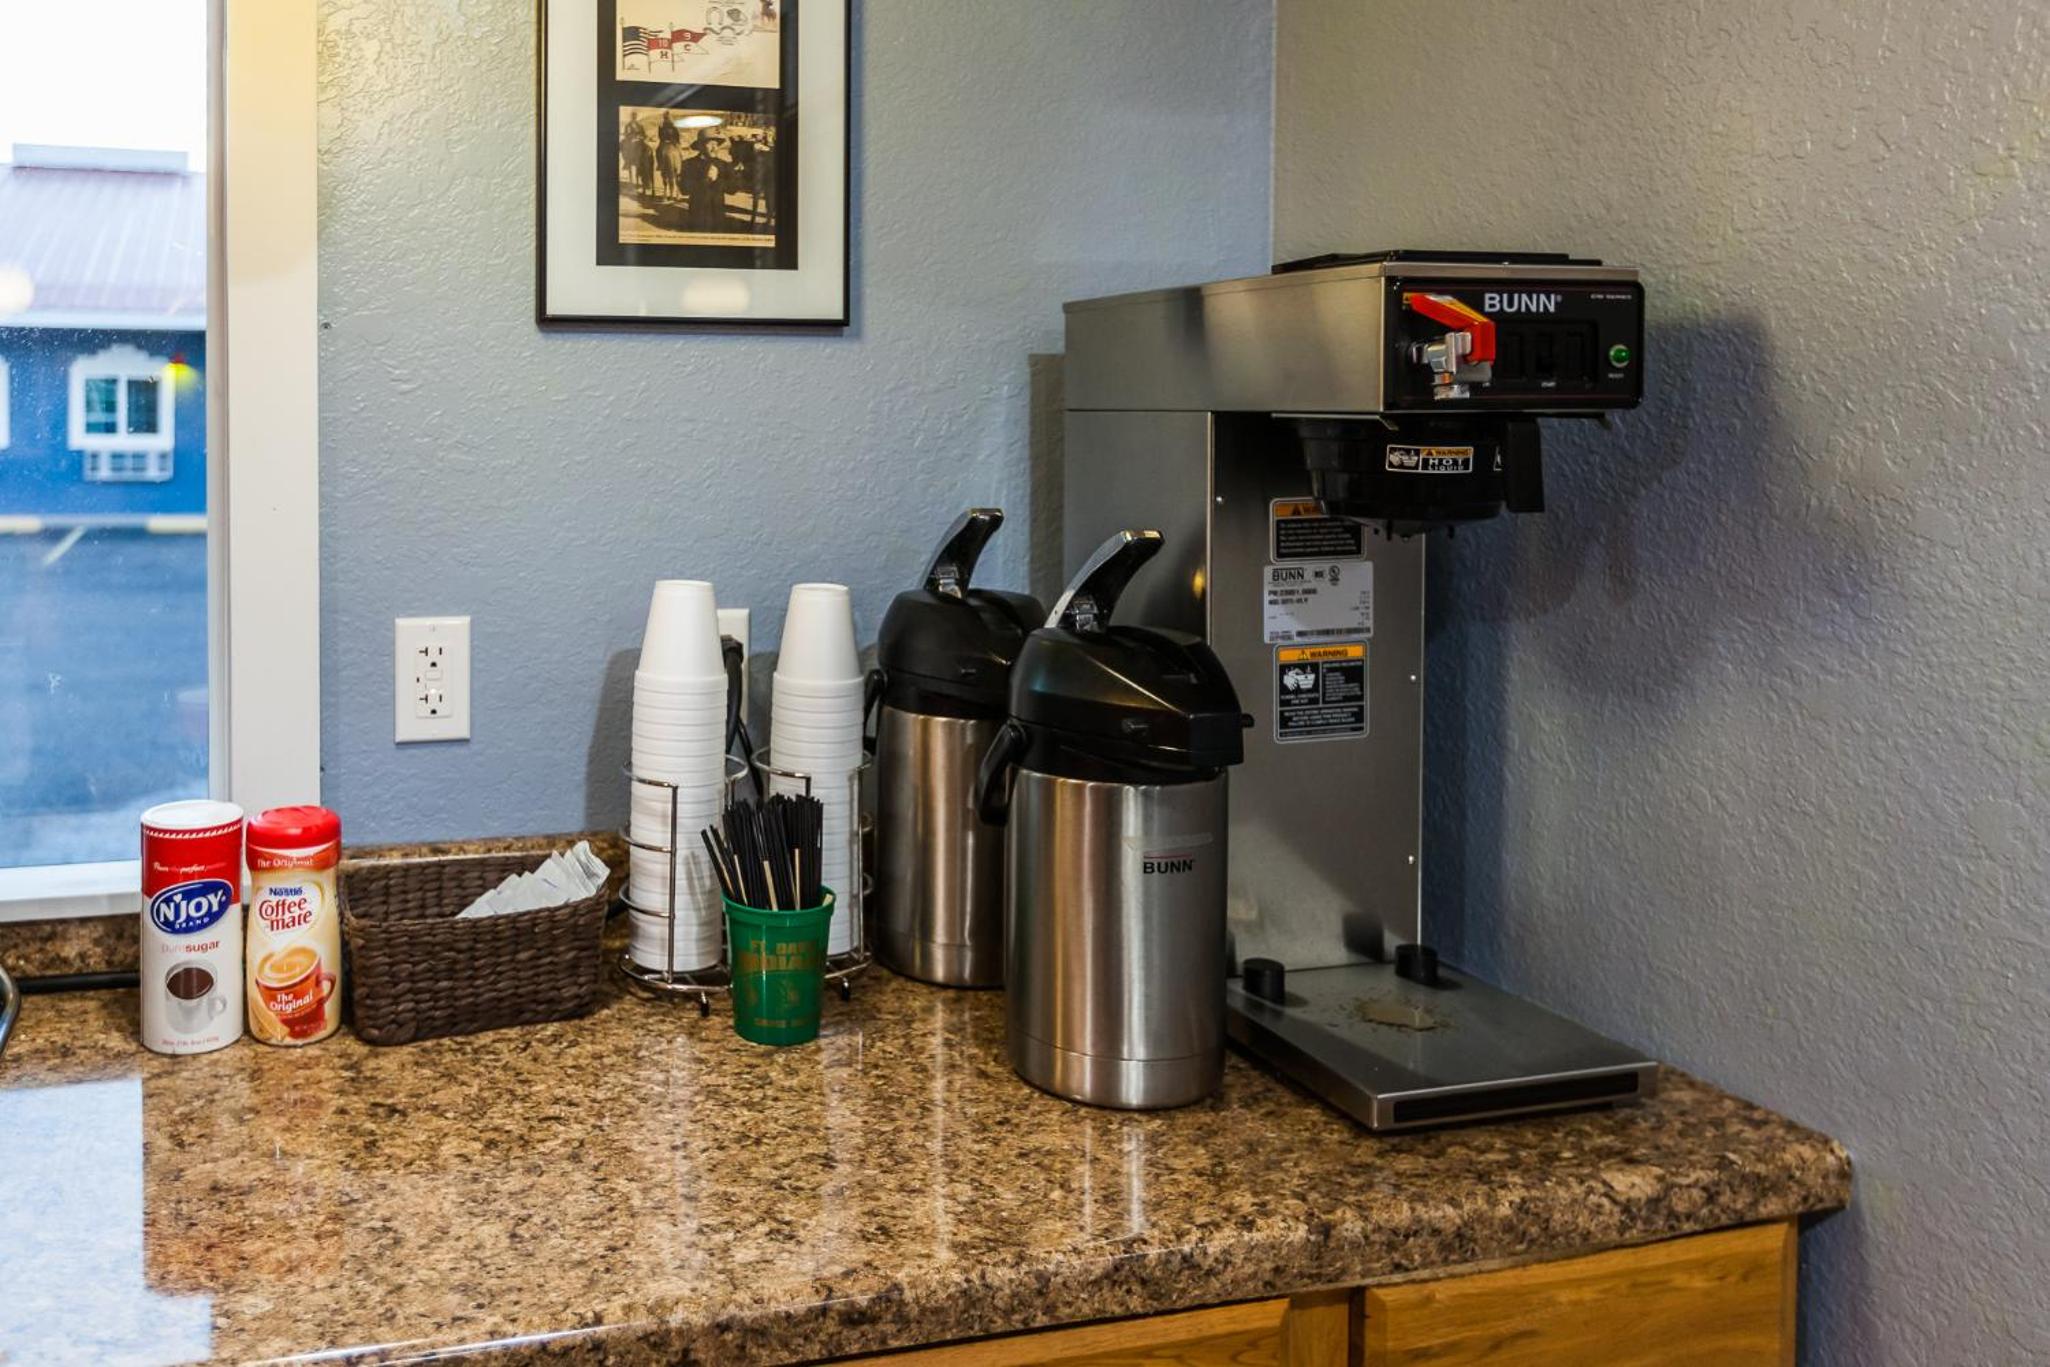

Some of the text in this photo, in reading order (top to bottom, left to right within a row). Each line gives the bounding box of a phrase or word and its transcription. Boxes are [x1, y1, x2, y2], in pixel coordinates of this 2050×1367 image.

[1484, 293, 1556, 313] BUNN
[1429, 458, 1464, 466] HOT
[1272, 568, 1304, 581] BUNN
[1309, 649, 1348, 658] WARNING
[1143, 860, 1193, 874] BUNN
[259, 897, 307, 921] Coffee
[185, 940, 220, 954] sugar
[270, 988, 313, 1013] Original
[277, 992, 294, 1003] The
